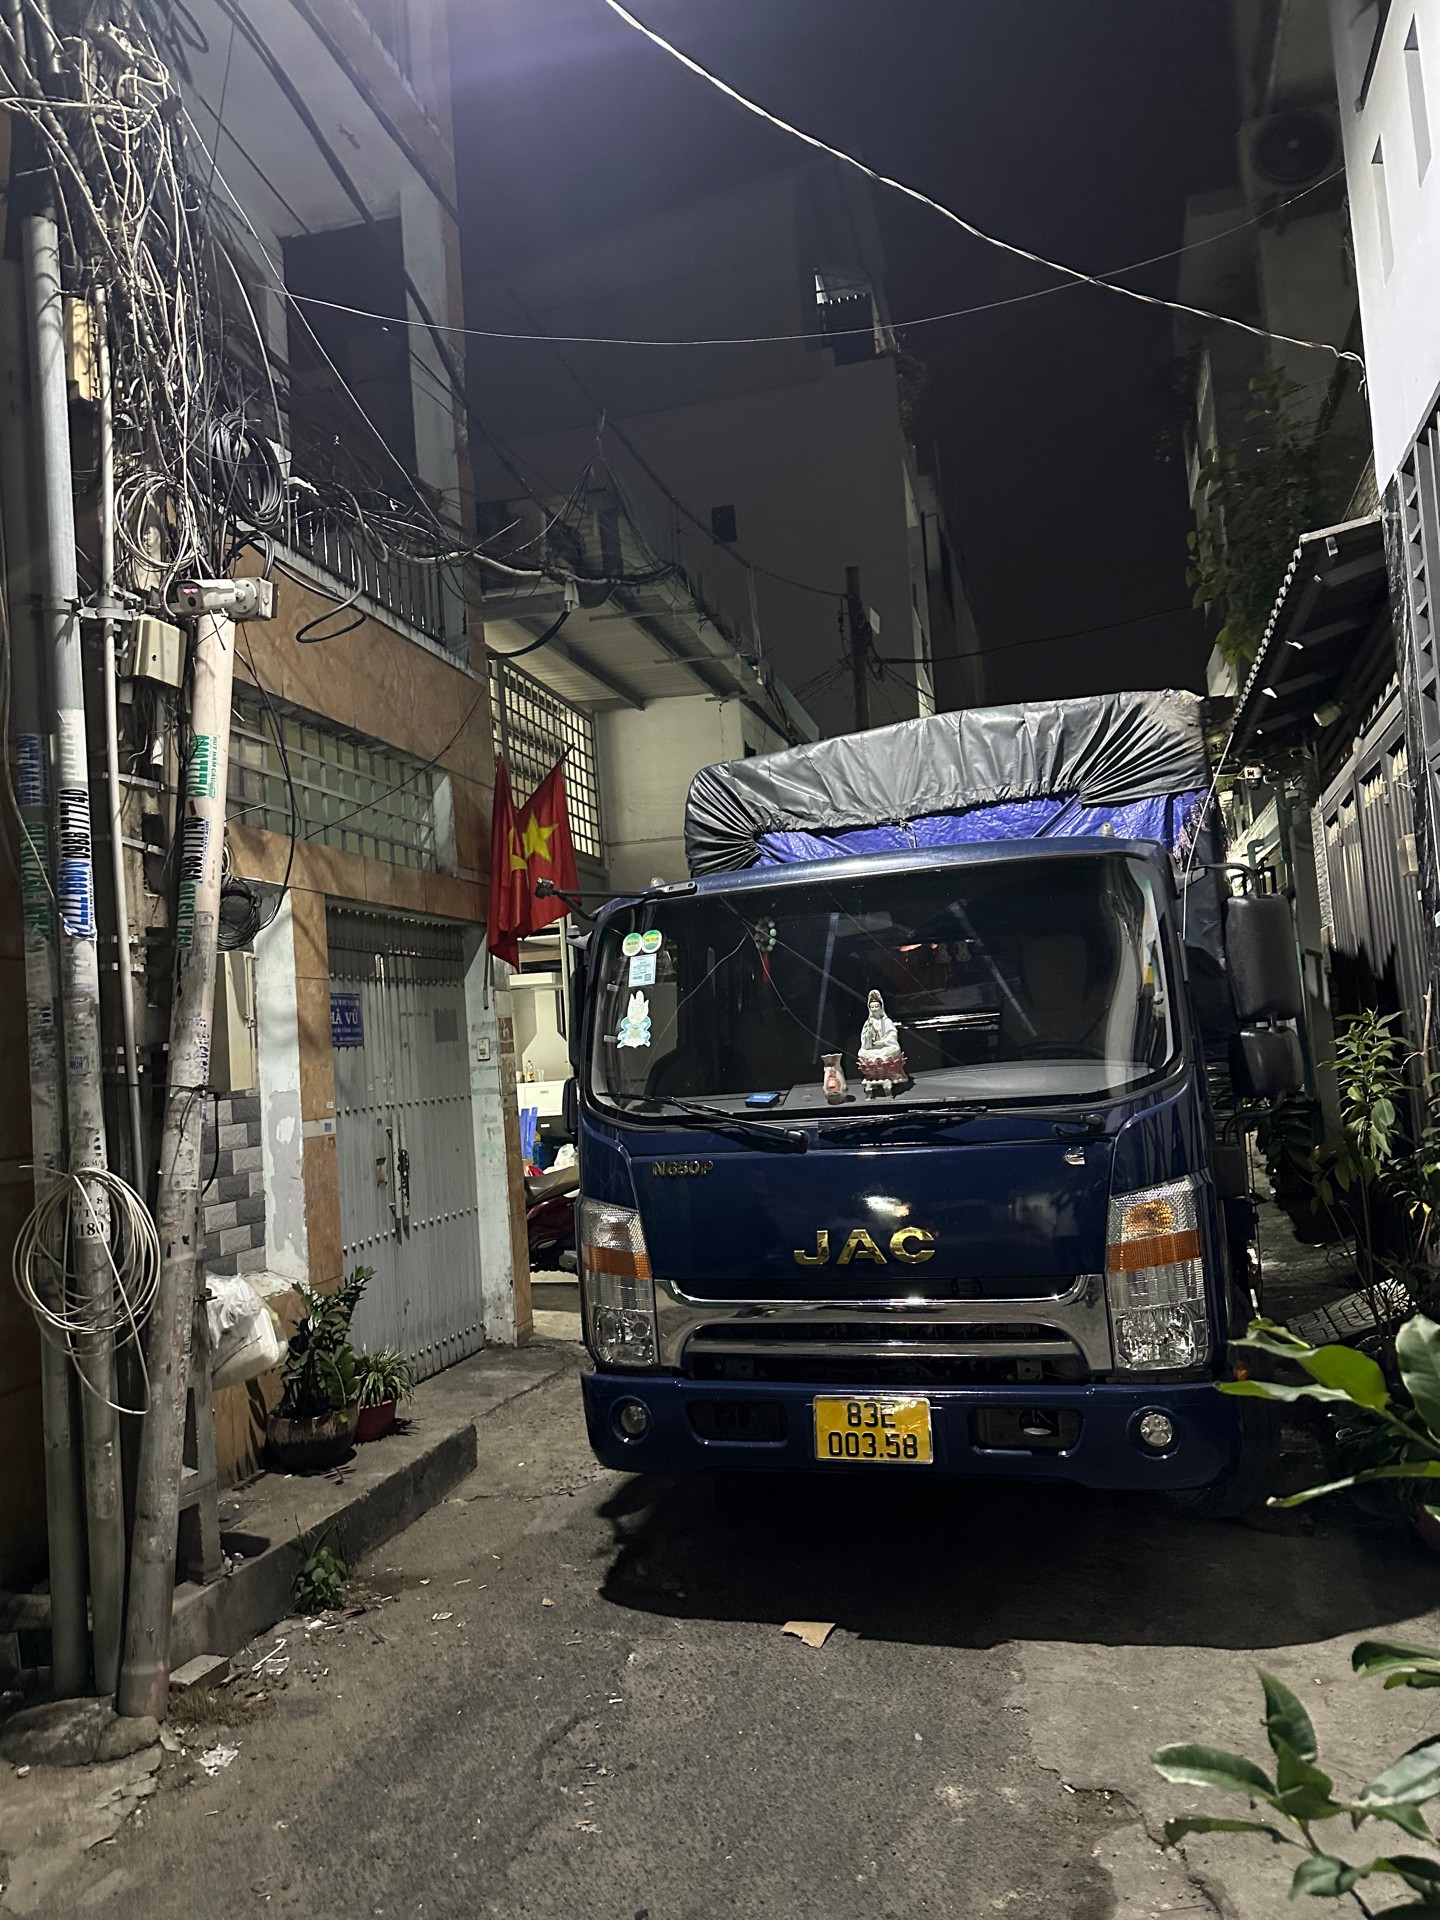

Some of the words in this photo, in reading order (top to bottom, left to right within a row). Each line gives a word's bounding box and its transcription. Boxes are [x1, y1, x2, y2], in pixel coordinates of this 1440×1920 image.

[652, 1160, 714, 1176] N650P
[793, 1226, 936, 1264] JAC
[847, 1402, 896, 1428] 83E
[828, 1432, 918, 1459] 003.58
